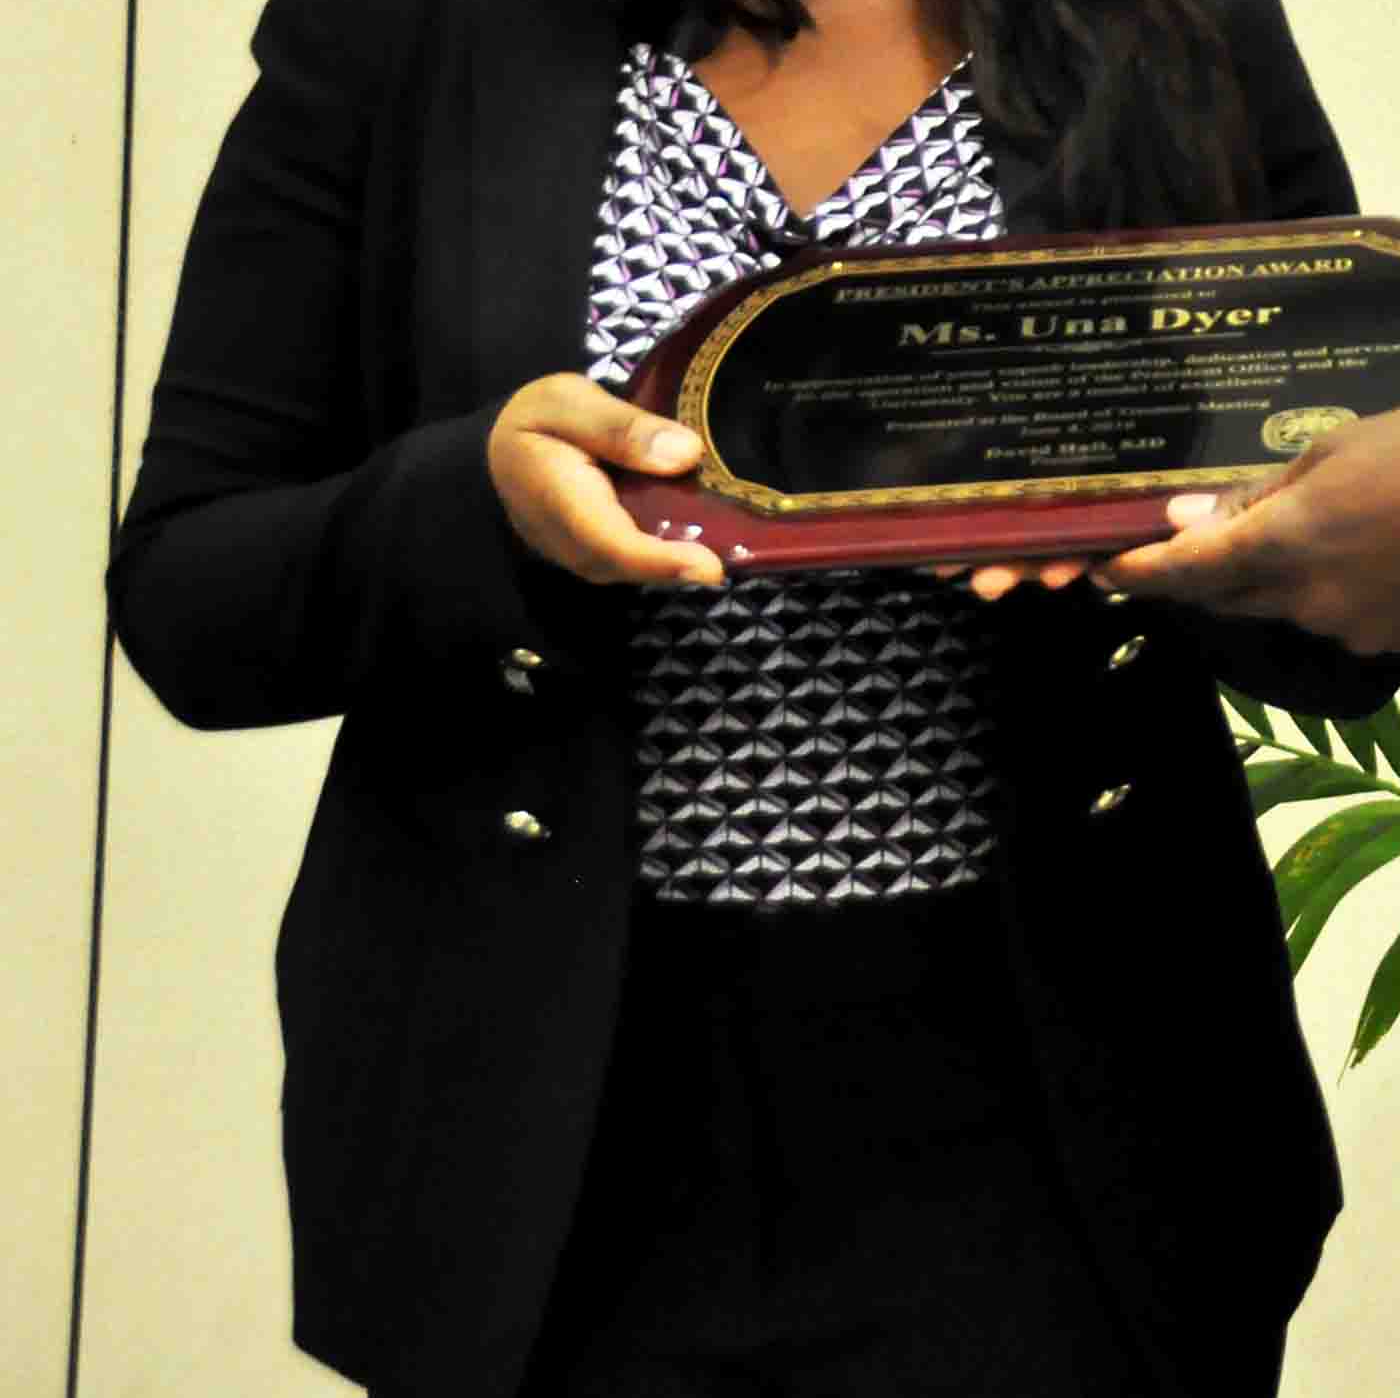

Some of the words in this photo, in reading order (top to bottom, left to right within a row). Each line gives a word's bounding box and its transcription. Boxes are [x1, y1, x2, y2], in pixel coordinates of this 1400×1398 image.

[835, 279, 1026, 303] PRESIDENT'S
[1027, 264, 1245, 291] APPRECIATION
[1250, 257, 1353, 278] AWARD
[898, 321, 997, 346] Ms.
[1020, 314, 1128, 339] Una
[1151, 305, 1283, 333] Dyer
